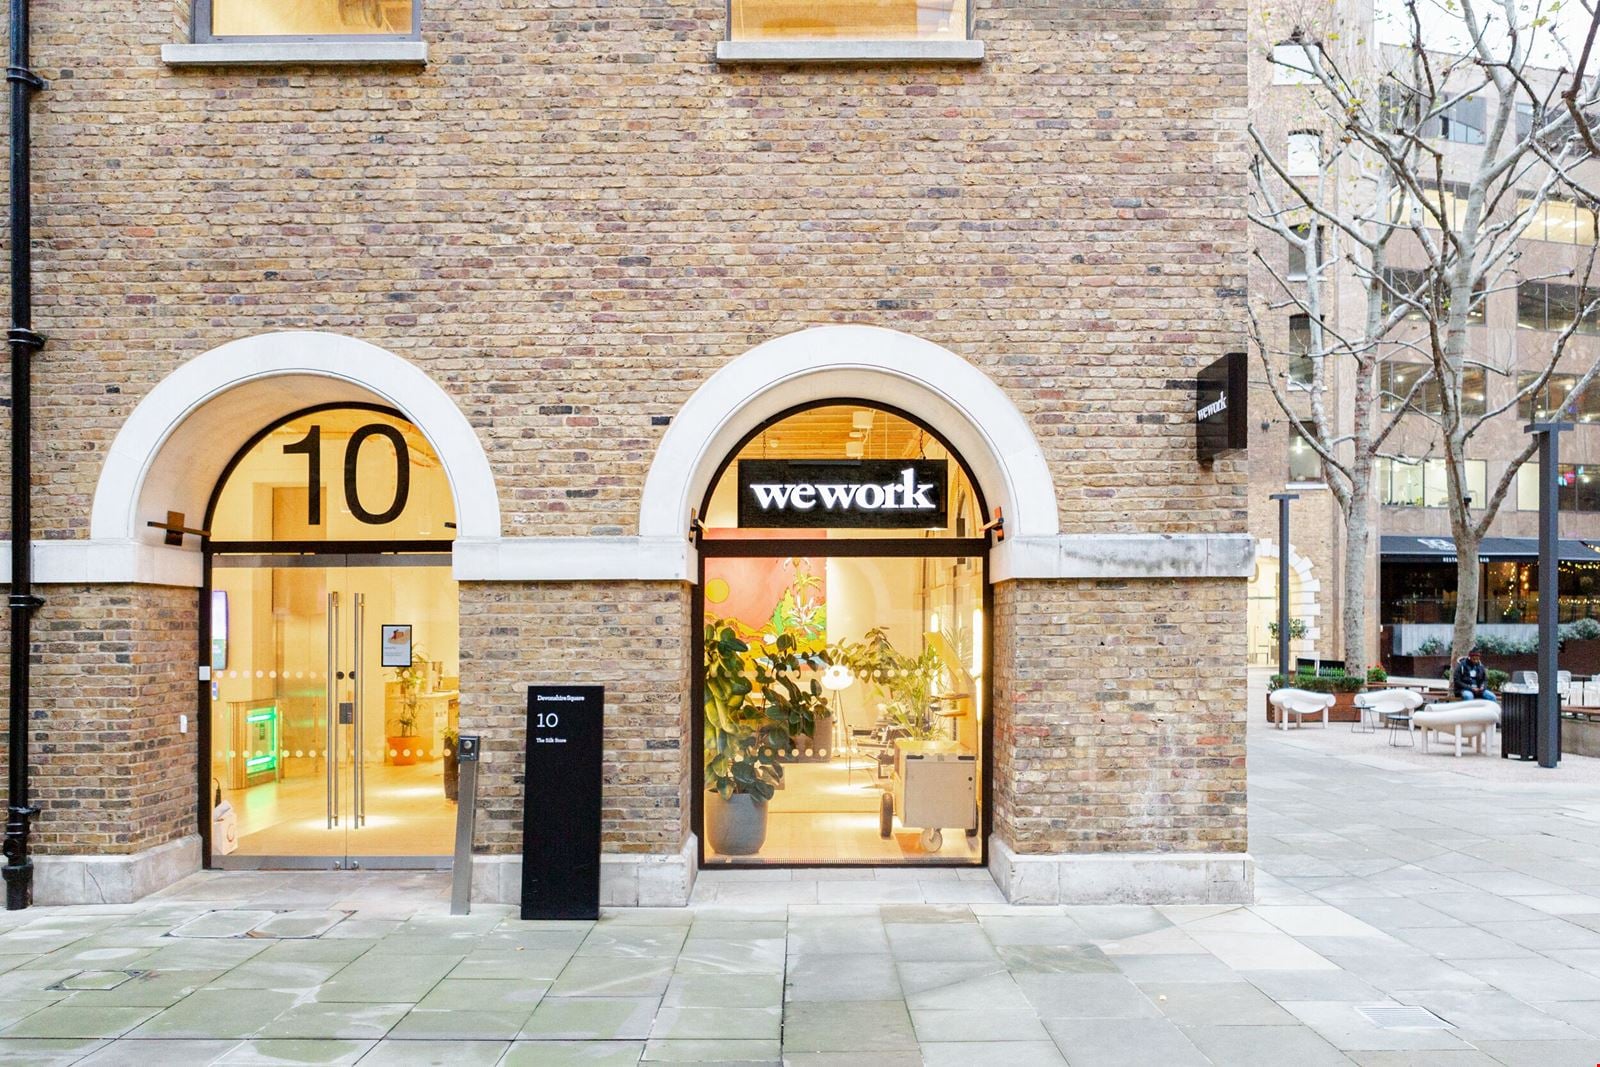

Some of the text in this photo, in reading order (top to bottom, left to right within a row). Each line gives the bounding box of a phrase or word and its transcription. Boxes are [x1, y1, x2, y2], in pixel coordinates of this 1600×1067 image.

[1197, 390, 1227, 421] wework
[283, 423, 410, 526] 10
[749, 467, 936, 510] wework
[537, 713, 558, 728] 10
